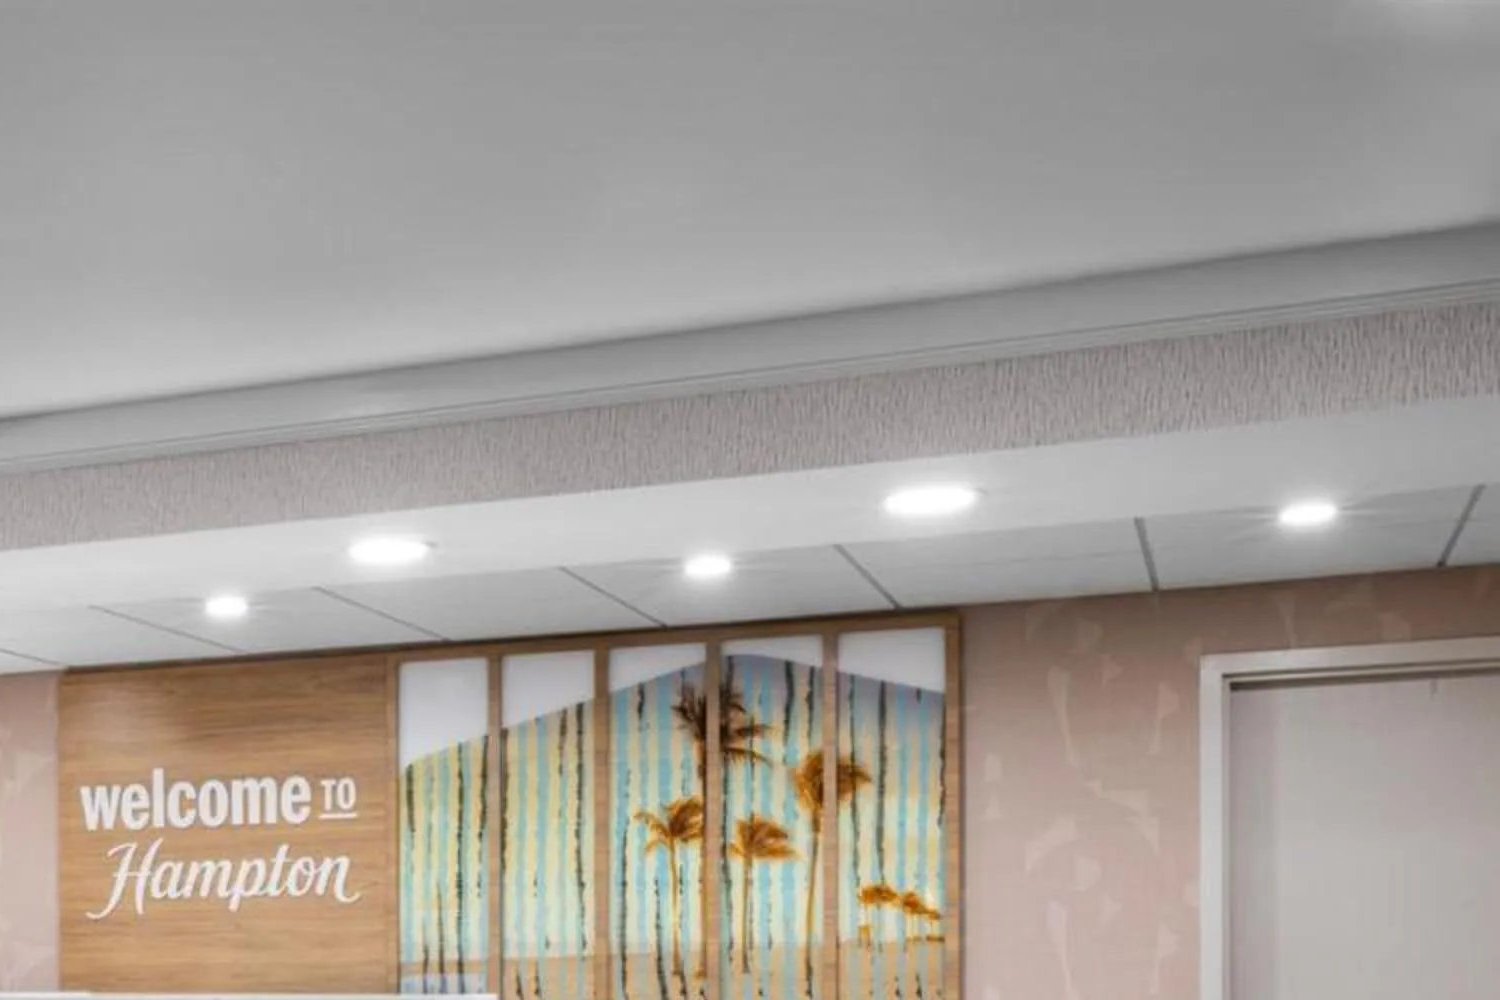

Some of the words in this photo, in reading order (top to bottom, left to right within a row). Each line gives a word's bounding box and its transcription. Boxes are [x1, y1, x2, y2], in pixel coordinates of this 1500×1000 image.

[80, 767, 311, 831] welcome
[320, 777, 357, 819] TO
[85, 837, 361, 920] Hampton
